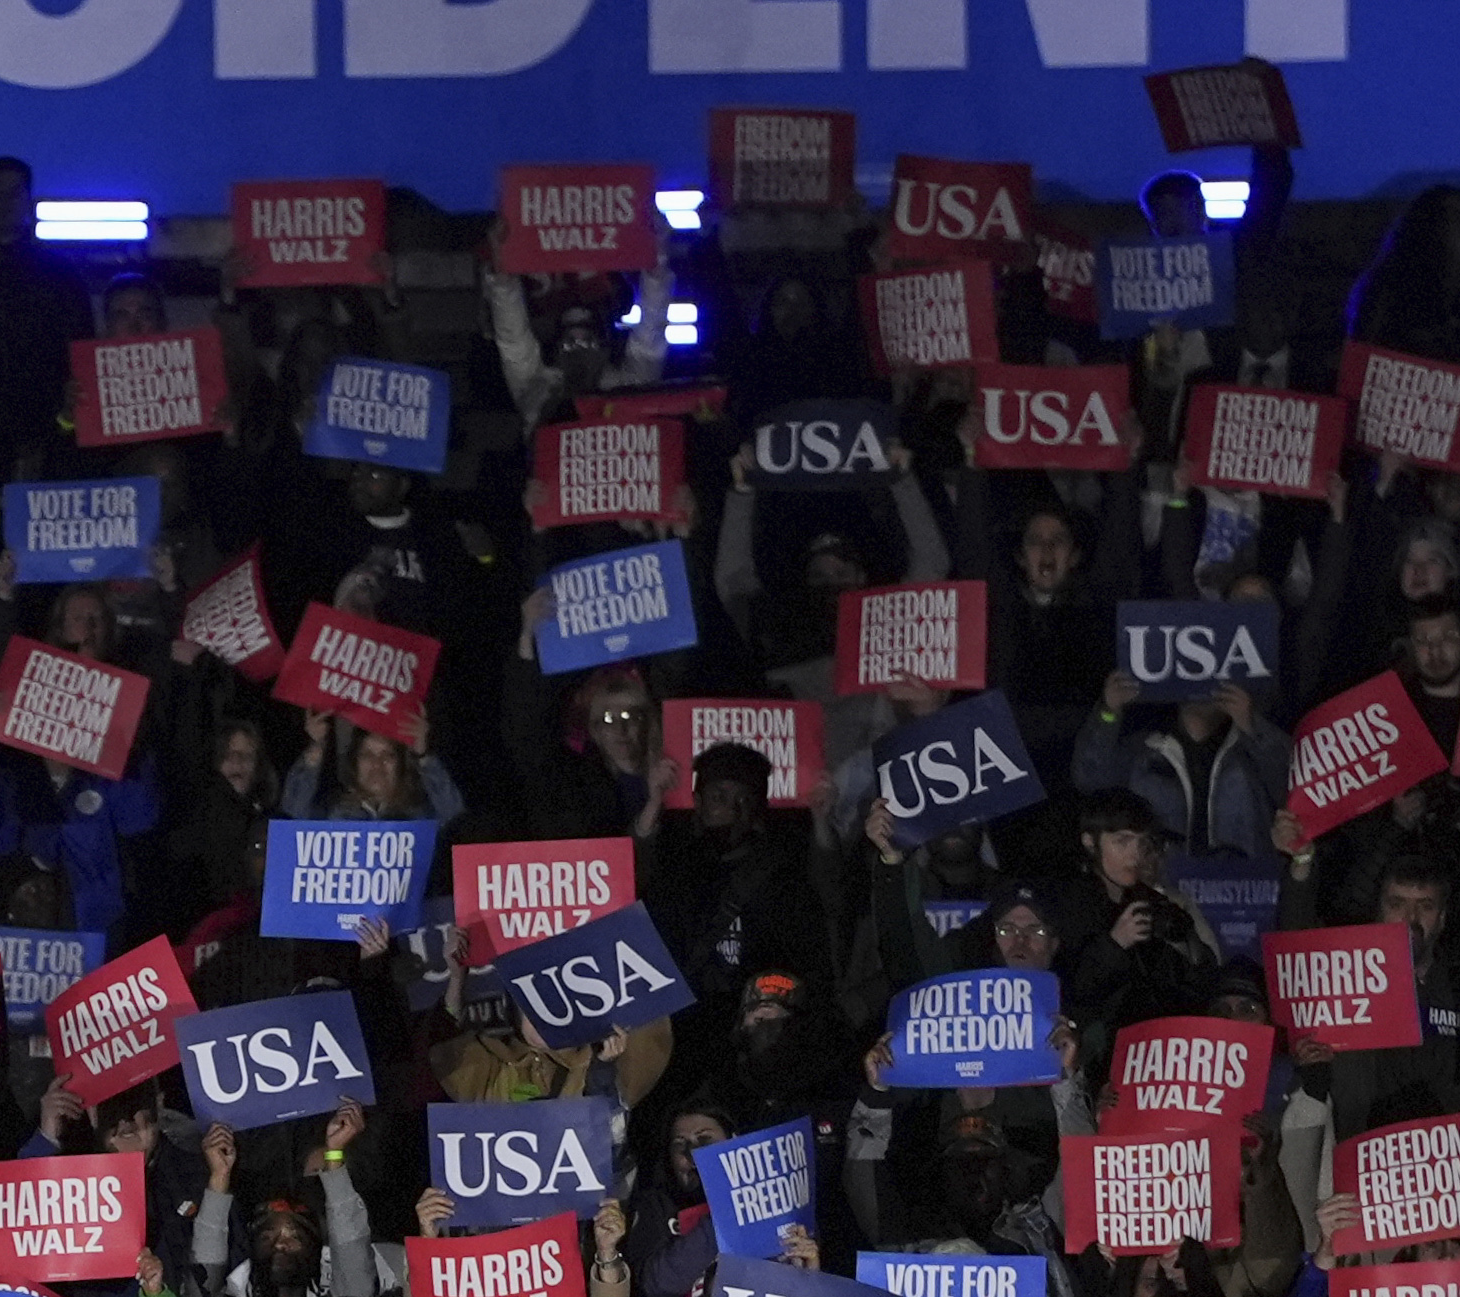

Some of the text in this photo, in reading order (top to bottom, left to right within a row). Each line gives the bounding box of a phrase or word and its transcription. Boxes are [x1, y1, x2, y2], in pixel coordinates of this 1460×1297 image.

[253, 198, 364, 237] HARRIS
[522, 186, 633, 225] HARRIS
[896, 180, 1021, 239] USA
[270, 240, 347, 262] WALZ
[539, 227, 616, 250] WALZ
[983, 389, 1118, 445] USA
[27, 487, 137, 518] VOTE FOR
[28, 518, 137, 550] FREEDOM
[1125, 626, 1268, 681] USA
[879, 727, 1027, 817] USA
[297, 832, 414, 868] VOTE FOR
[292, 868, 410, 904] FREEDOM
[59, 966, 168, 1057] HARRIS
[909, 979, 1032, 1018] VOTE FOR
[81, 1019, 166, 1074] WALZ
[907, 1014, 1032, 1054] FREEDOM
[188, 1020, 363, 1103] USA
[13, 1227, 103, 1256] WALZ
